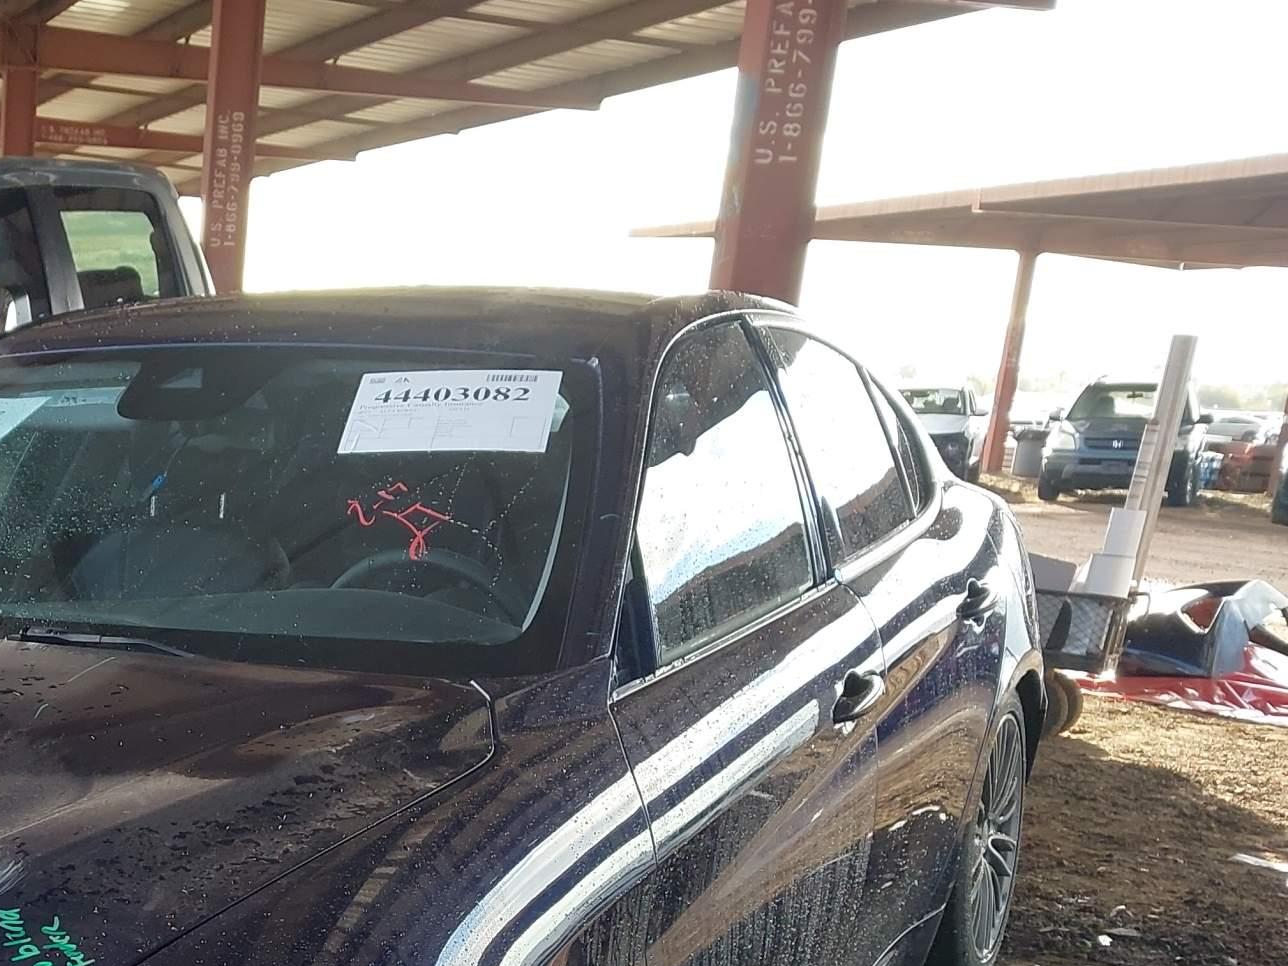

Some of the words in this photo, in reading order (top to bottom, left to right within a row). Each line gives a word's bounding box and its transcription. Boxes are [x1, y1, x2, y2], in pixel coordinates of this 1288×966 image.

[754, 112, 779, 165] U.S.
[212, 147, 229, 209] PREFAB
[373, 386, 531, 403] 44403082
